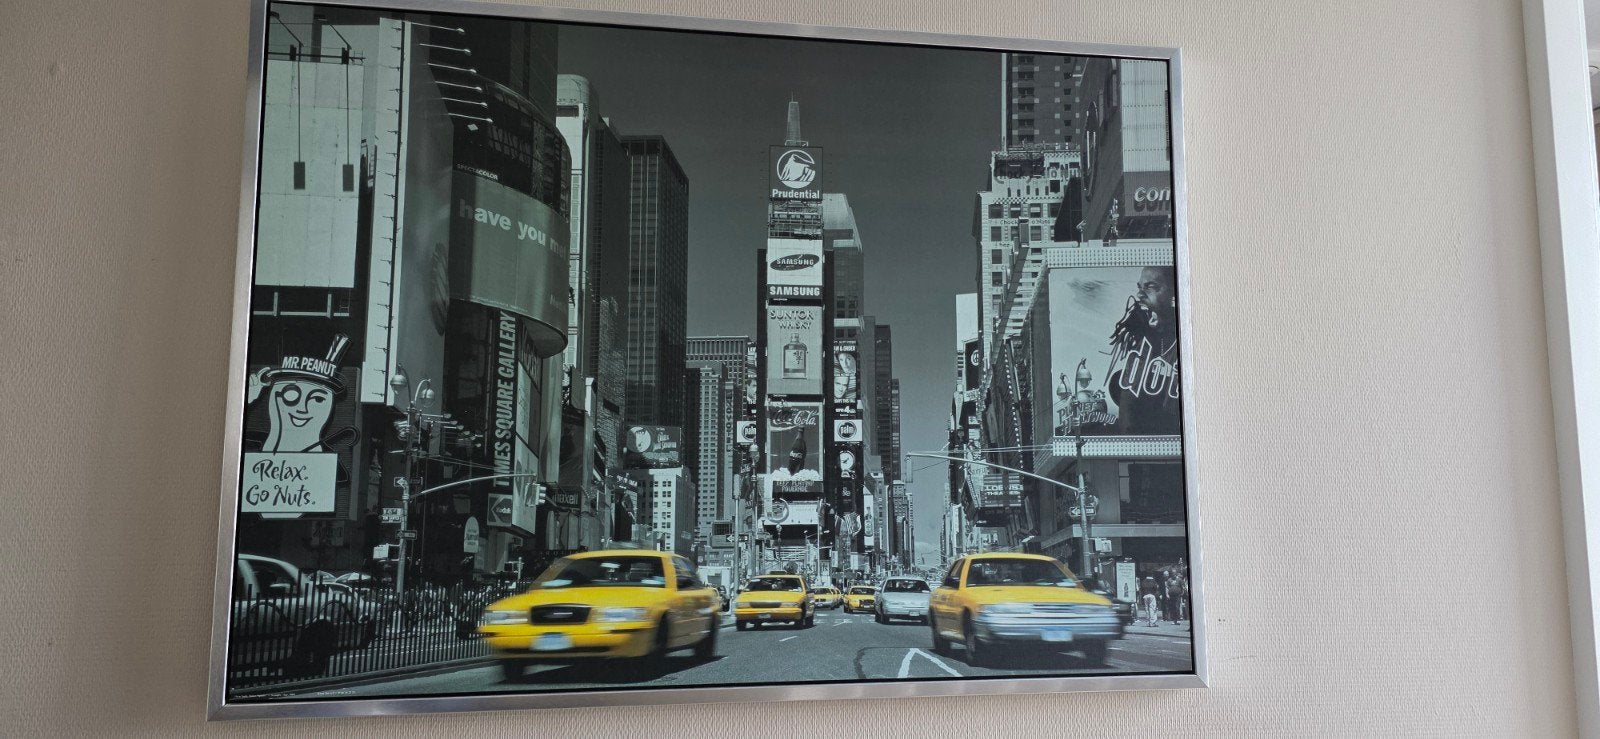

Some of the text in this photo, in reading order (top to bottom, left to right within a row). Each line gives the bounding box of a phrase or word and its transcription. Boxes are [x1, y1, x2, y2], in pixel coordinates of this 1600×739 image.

[772, 188, 820, 199] Prudential
[459, 198, 512, 231] have
[517, 220, 547, 247] you
[776, 258, 815, 266] SAMSUNG
[769, 285, 820, 297] SAMSUNG
[282, 356, 337, 377] MR. PEANUT
[493, 310, 516, 488] TIMES SQUARE GALLERY
[252, 459, 309, 481] Relax.
[246, 484, 316, 507] Go Nuts.
